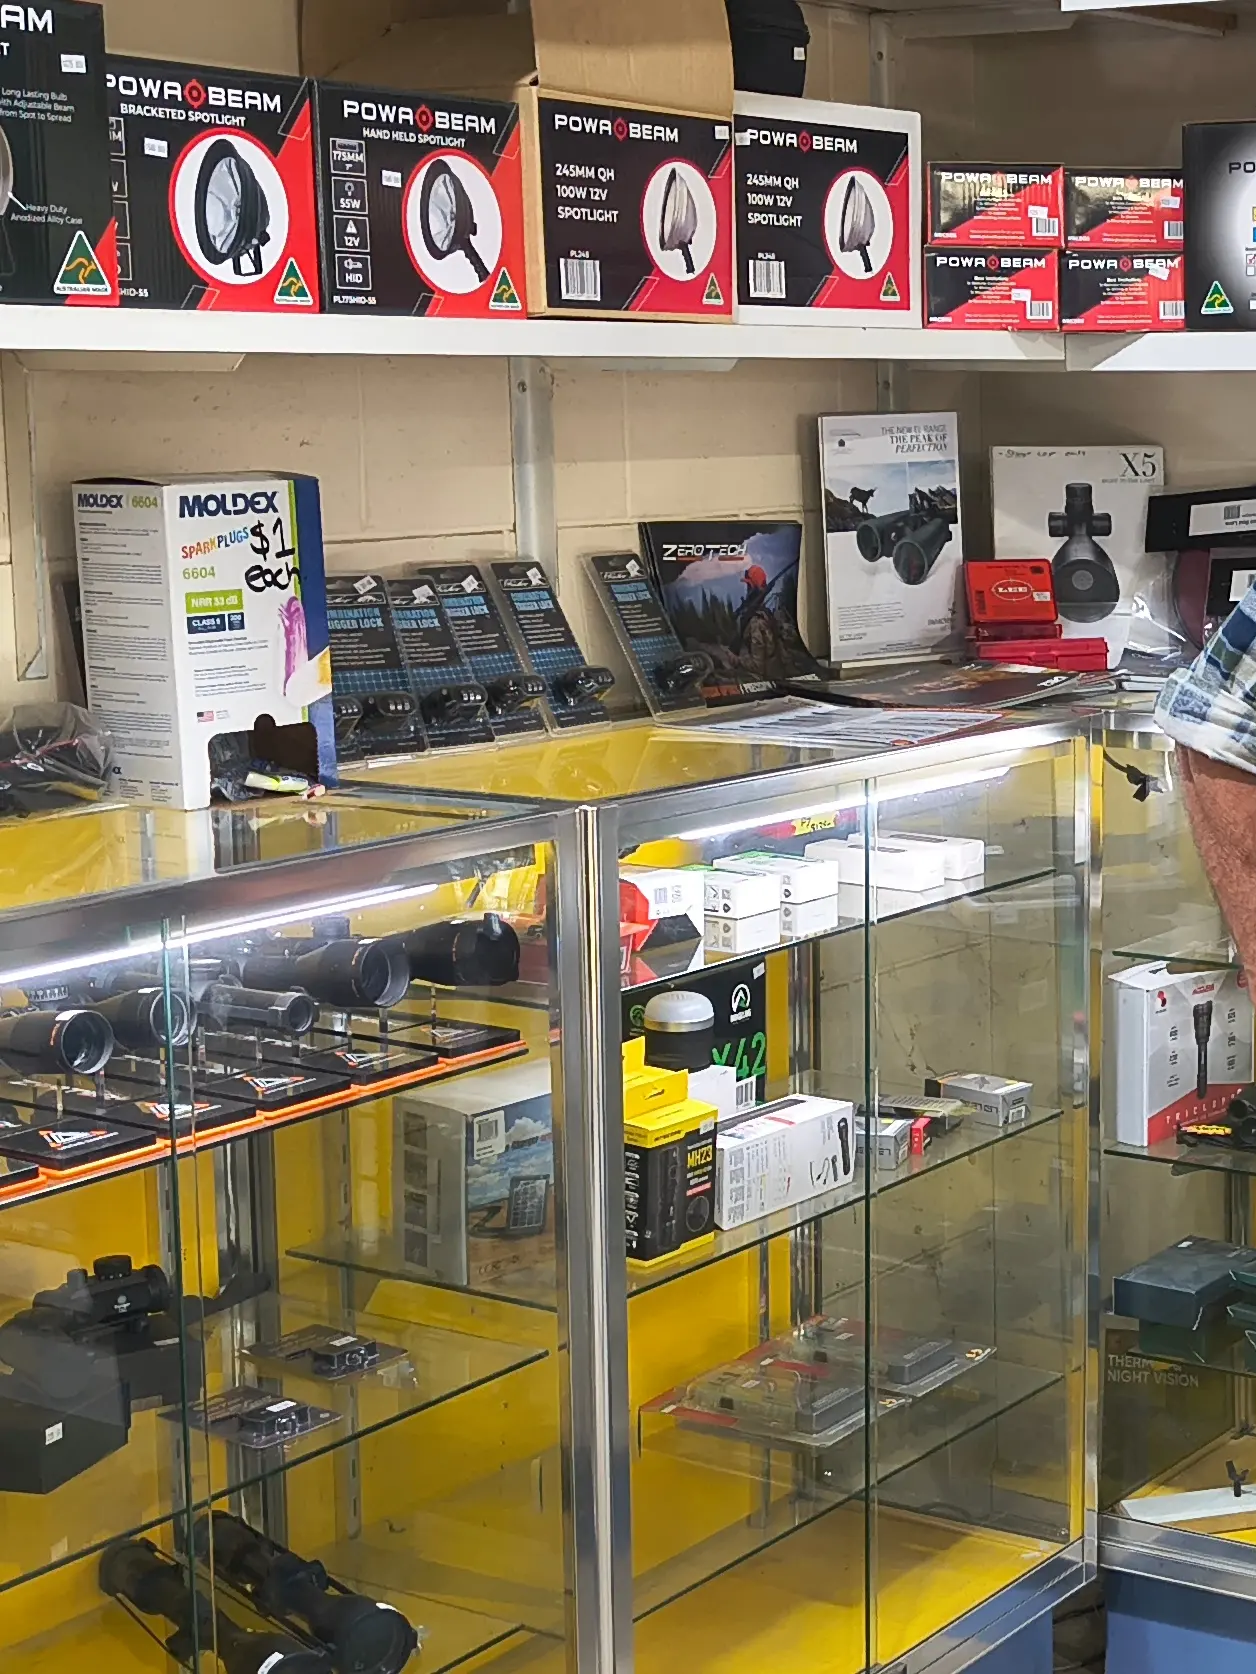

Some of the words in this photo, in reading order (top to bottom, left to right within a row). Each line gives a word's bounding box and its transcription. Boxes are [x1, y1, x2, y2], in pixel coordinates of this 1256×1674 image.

[208, 87, 281, 113] BEAM
[121, 103, 186, 120] BRACKETED
[188, 109, 246, 127] SPOTLIGHT
[343, 100, 414, 125] POWA
[435, 110, 496, 134] BEAM
[554, 114, 612, 136] POWA
[629, 122, 679, 142] BEAM
[362, 127, 391, 140] HAND
[392, 130, 416, 143] HELD
[417, 132, 466, 148] SPOTLIGHT
[747, 128, 798, 147] POWA
[812, 136, 857, 154] BEAM
[555, 164, 595, 181] 245MM
[598, 167, 615, 182] QH
[941, 171, 991, 185] POWA
[1007, 173, 1052, 185] BEAM
[747, 174, 782, 188] 245MM
[784, 177, 799, 190] QH
[1075, 177, 1124, 188] POWA
[557, 185, 586, 200] 100W
[589, 187, 607, 201] 12V
[747, 193, 774, 207] 100W
[776, 194, 792, 207] 12V
[340, 198, 361, 209] 55W
[557, 206, 619, 224] SPOTLIGHT
[747, 213, 802, 228] SPOTLIGHT
[344, 236, 360, 247] 12V
[936, 256, 985, 268] POWA
[1001, 256, 1046, 268] BEAM
[1069, 259, 1117, 270] POWA
[345, 272, 363, 283] HID
[118, 288, 149, 297] HID-55
[1119, 452, 1156, 477] X5
[77, 493, 123, 509] MOLDEX
[131, 496, 158, 508] 6604
[179, 491, 279, 518] MOLDEX
[250, 517, 295, 561] $1
[182, 566, 216, 580] 6604
[245, 562, 300, 592] each
[192, 618, 215, 627] CLASS
[360, 618, 384, 628] LOCK
[687, 1145, 712, 1168] MH23
[1108, 1354, 1160, 1371] THERM
[1108, 1370, 1150, 1384] NIGHT
[1154, 1372, 1199, 1387] VISION
